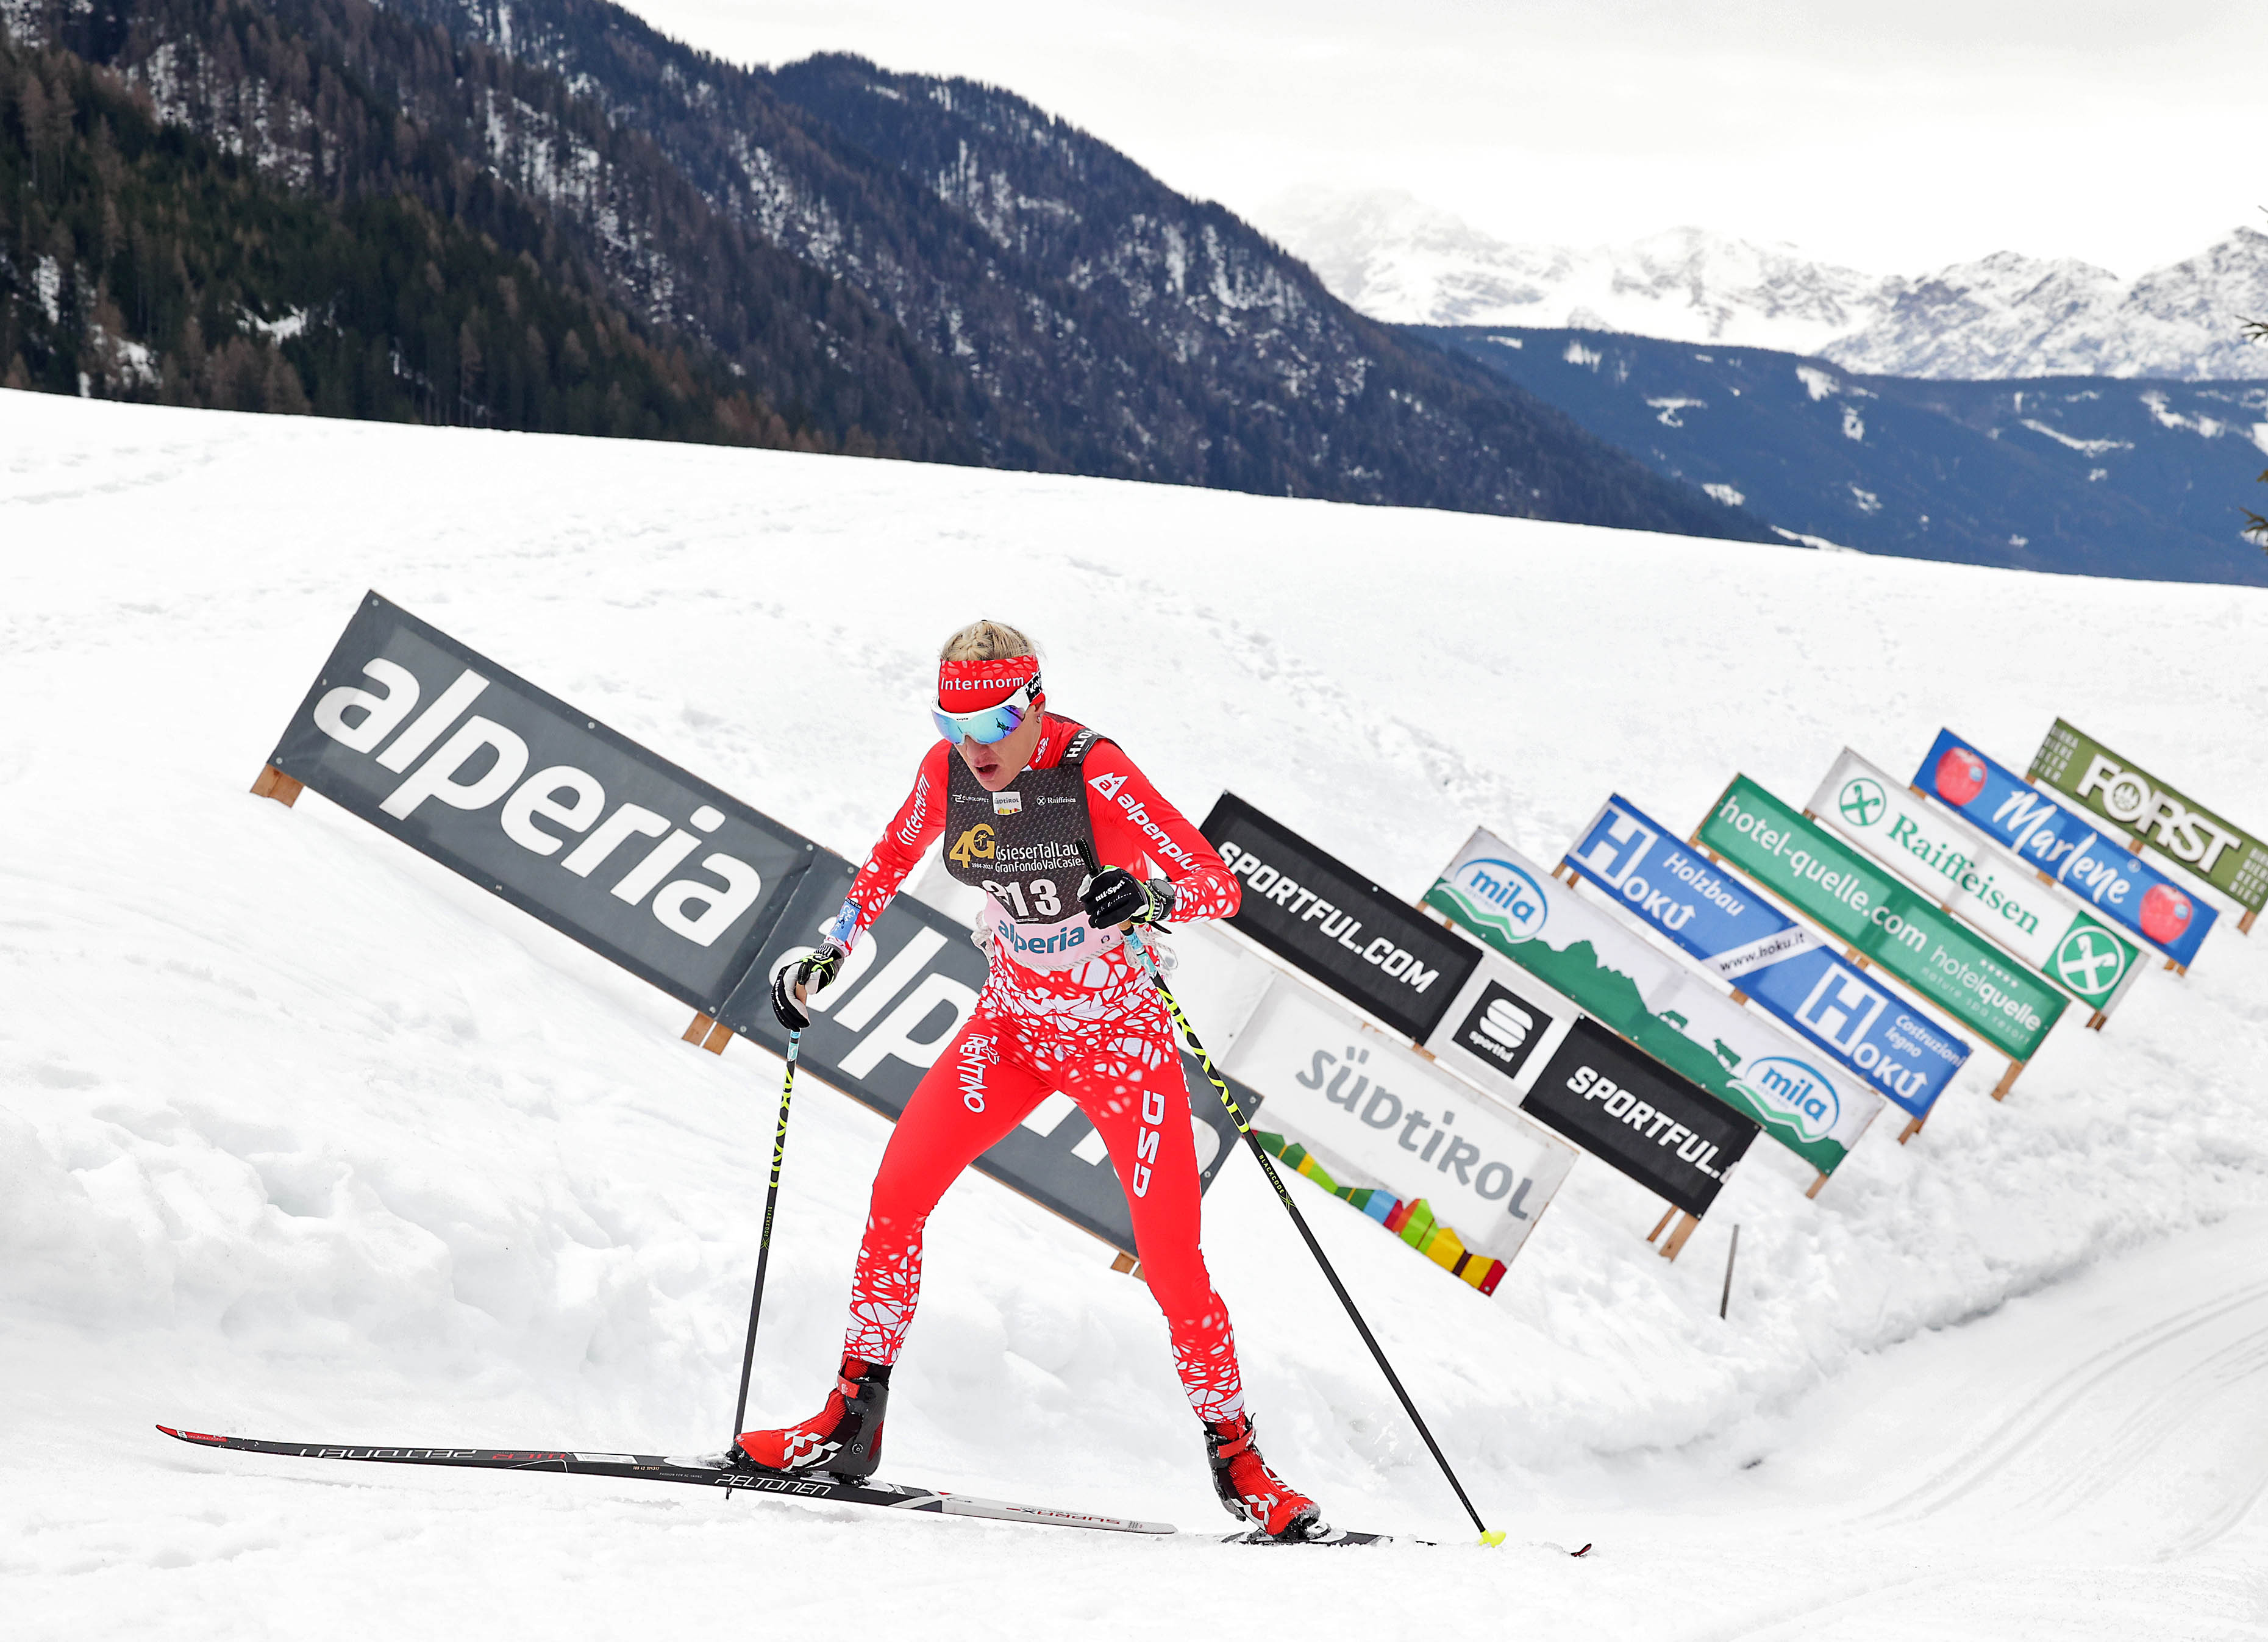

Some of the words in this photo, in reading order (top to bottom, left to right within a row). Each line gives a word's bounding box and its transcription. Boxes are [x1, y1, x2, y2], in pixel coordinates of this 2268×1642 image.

[941, 677, 1025, 690] Internorm
[313, 657, 761, 947] alperia
[2076, 753, 2242, 874] FORST
[996, 841, 1079, 861] GsieserTalLau
[1718, 796, 1927, 952] hotel-quelle.com
[1886, 812, 2040, 936] Raiffeisen
[1993, 788, 2131, 905] Marlene
[1469, 868, 1536, 924] mila
[1662, 851, 1746, 916] Holzbau
[998, 919, 1085, 954] alperia
[1218, 841, 1439, 994] SPORTFUL.COM
[1720, 932, 1805, 972] www.hoku.it
[1930, 944, 2041, 1031] hotelquelle
[1468, 1030, 1515, 1063] sportful
[1885, 1026, 1922, 1058] legno
[957, 1033, 998, 1113] TRENTINO
[1758, 1064, 1828, 1123] mila
[1133, 1090, 1165, 1198] GSG
[1258, 1154, 1285, 1194] BLACKCODE
[763, 1205, 773, 1237] BLACKCODE
[299, 1448, 477, 1459] PELTONEN
[715, 1474, 832, 1496] PELTONEN
